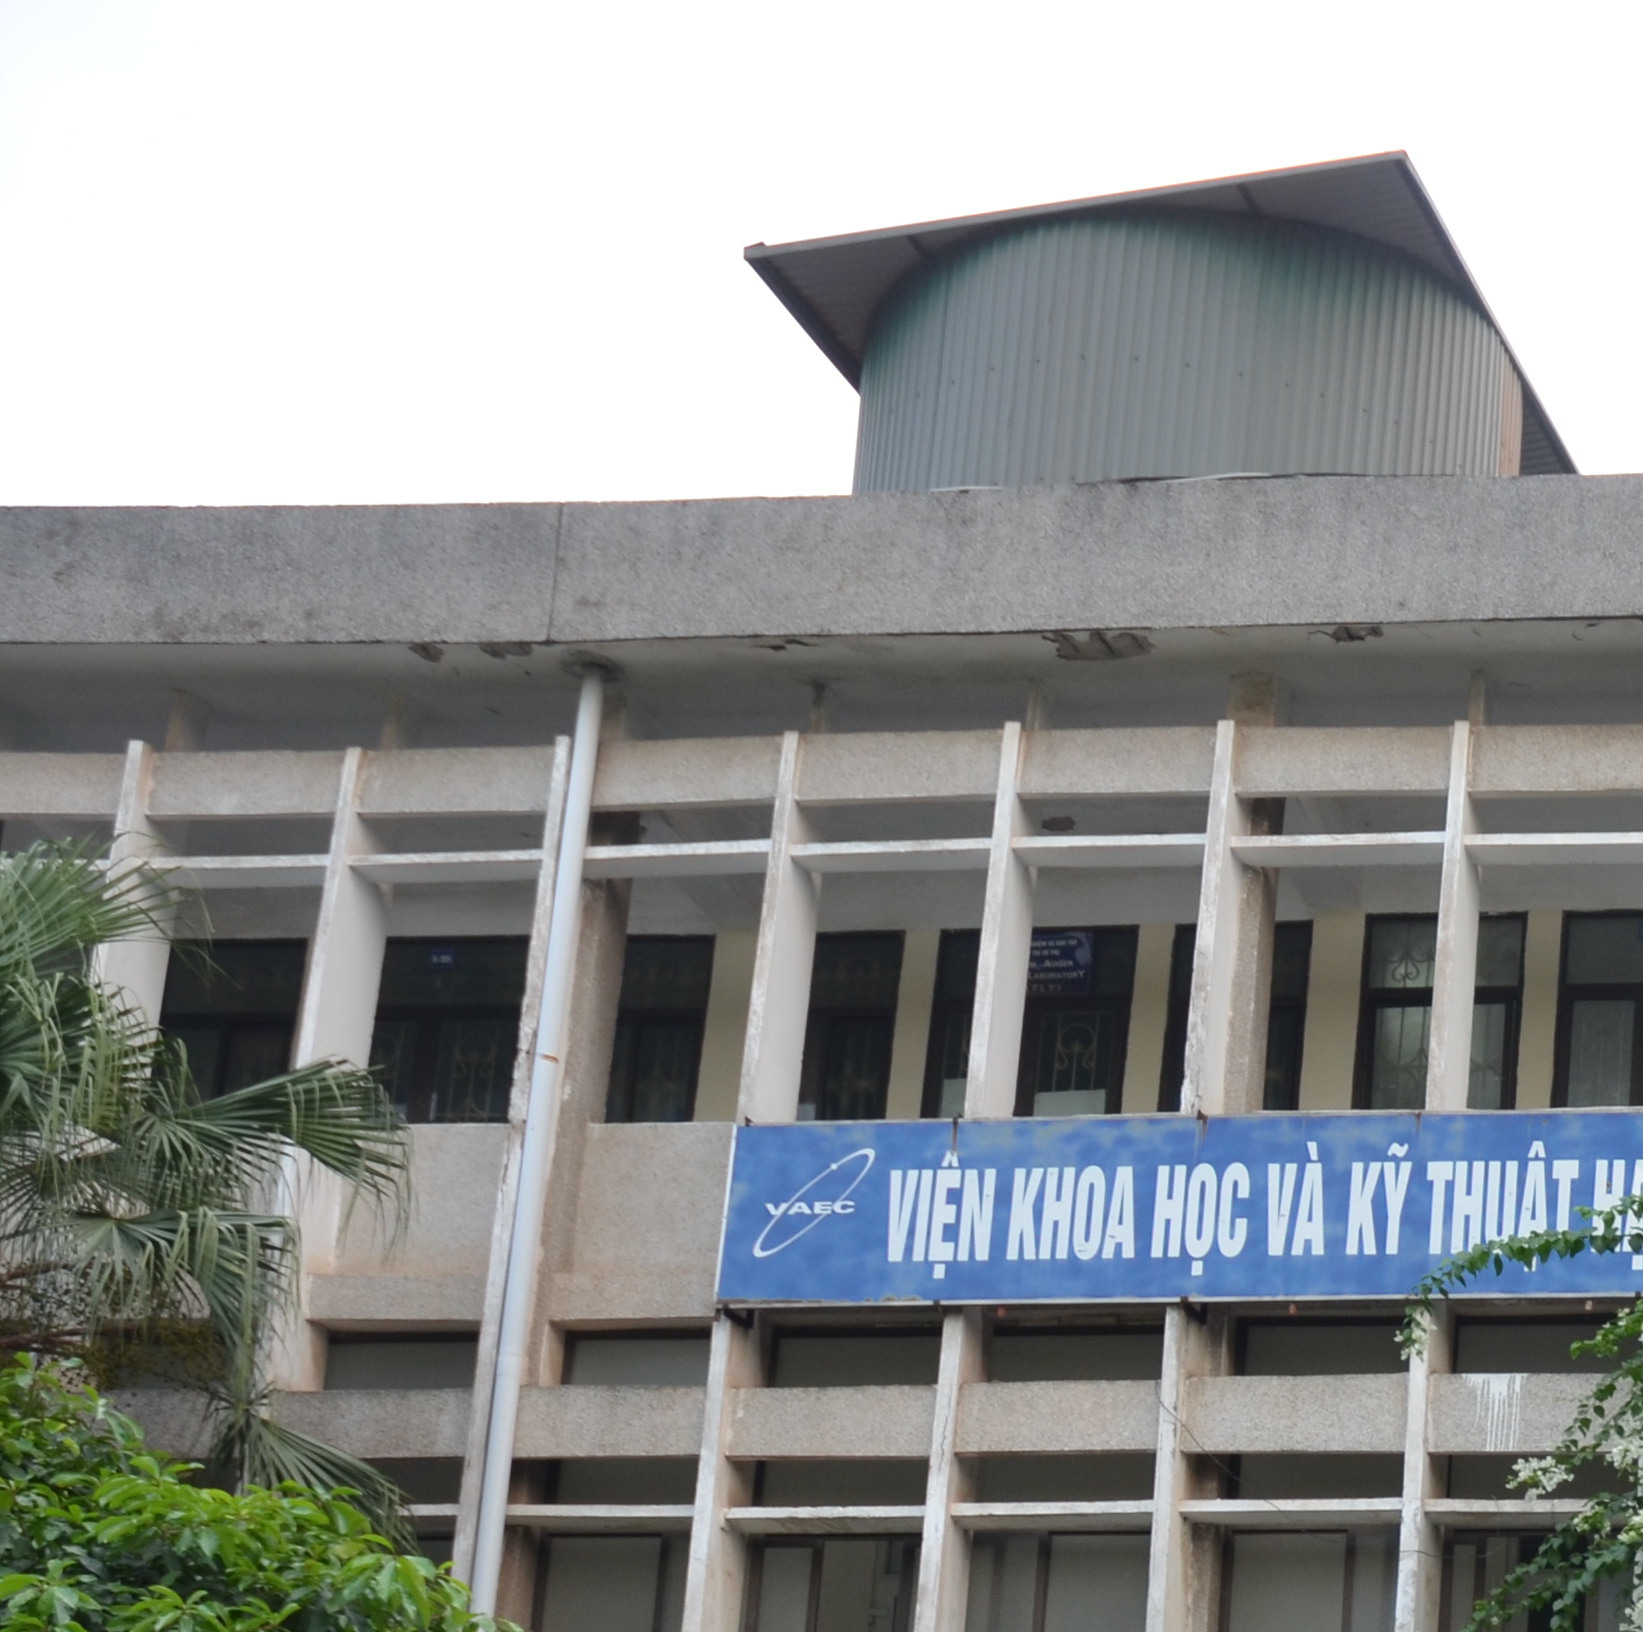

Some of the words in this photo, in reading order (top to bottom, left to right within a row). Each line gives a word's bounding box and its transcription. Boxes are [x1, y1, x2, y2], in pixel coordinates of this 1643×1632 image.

[764, 1200, 857, 1215] VAEC
[887, 1149, 997, 1280] VIỆN
[1006, 1164, 1136, 1261] KHOA
[1150, 1162, 1251, 1277] HỌC
[1266, 1140, 1325, 1256] VÀ
[1345, 1141, 1414, 1256] KỸ
[1427, 1139, 1579, 1272] THUẬT
